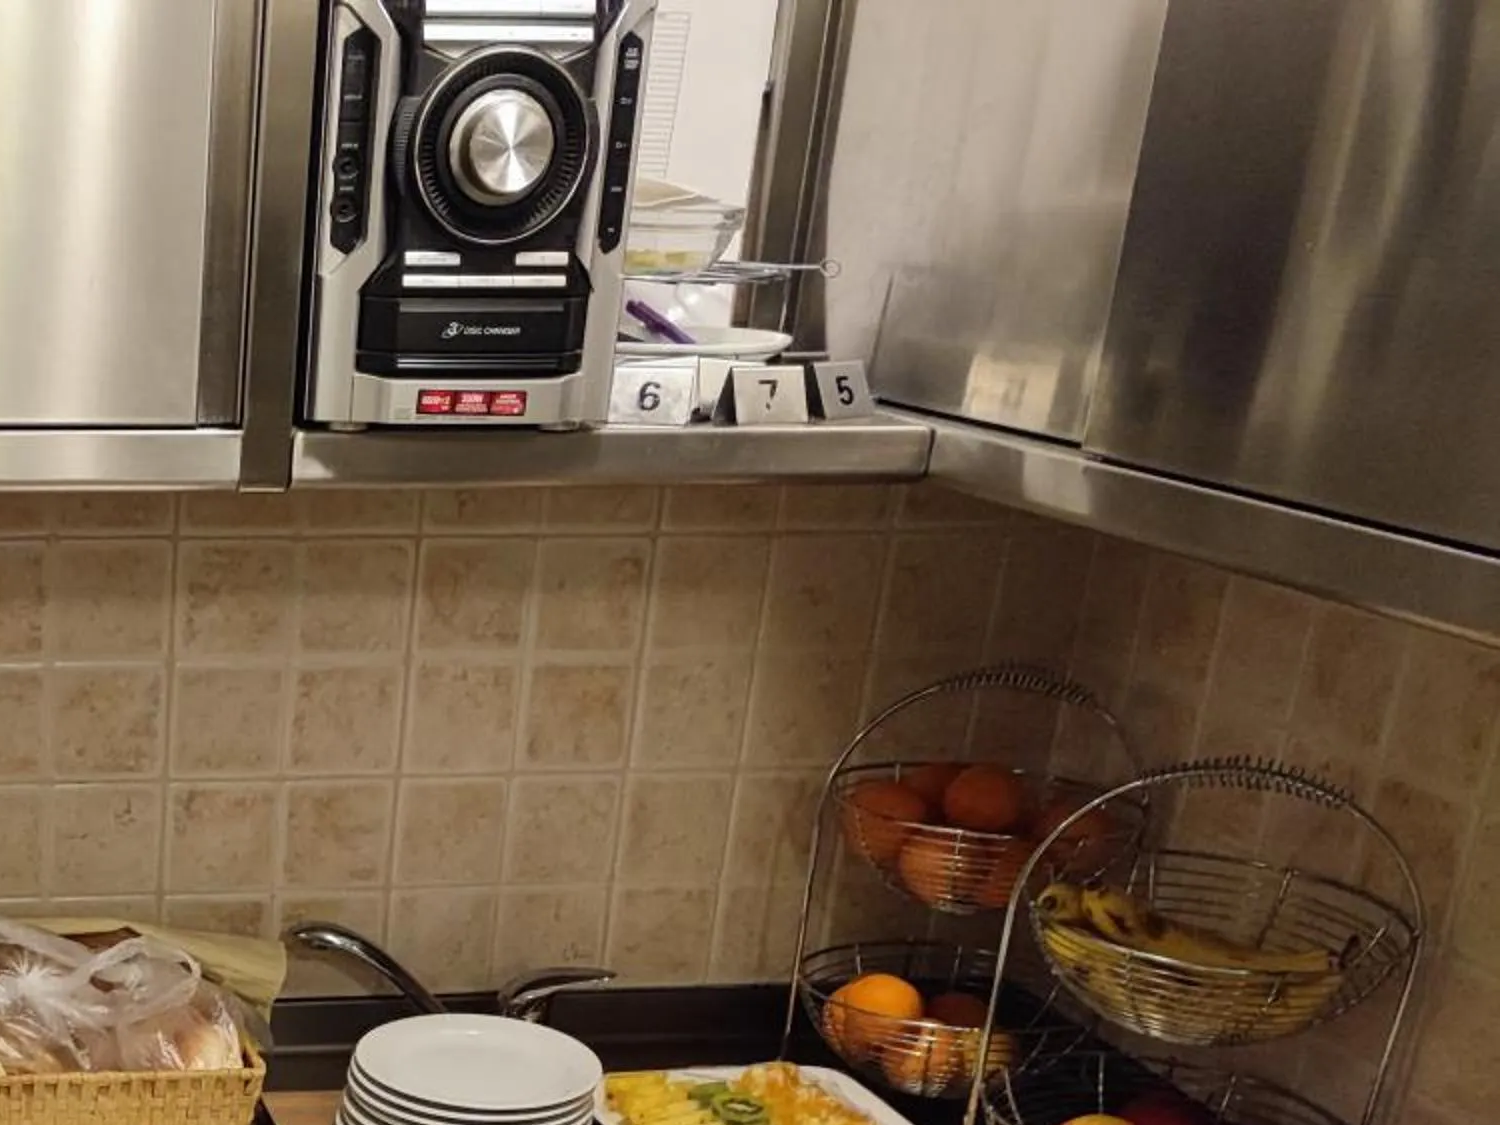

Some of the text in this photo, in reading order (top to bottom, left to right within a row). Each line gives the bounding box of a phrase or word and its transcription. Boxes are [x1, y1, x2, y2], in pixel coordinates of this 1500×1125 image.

[638, 382, 661, 411] 6
[758, 379, 779, 411] 7
[835, 376, 855, 406] 5
